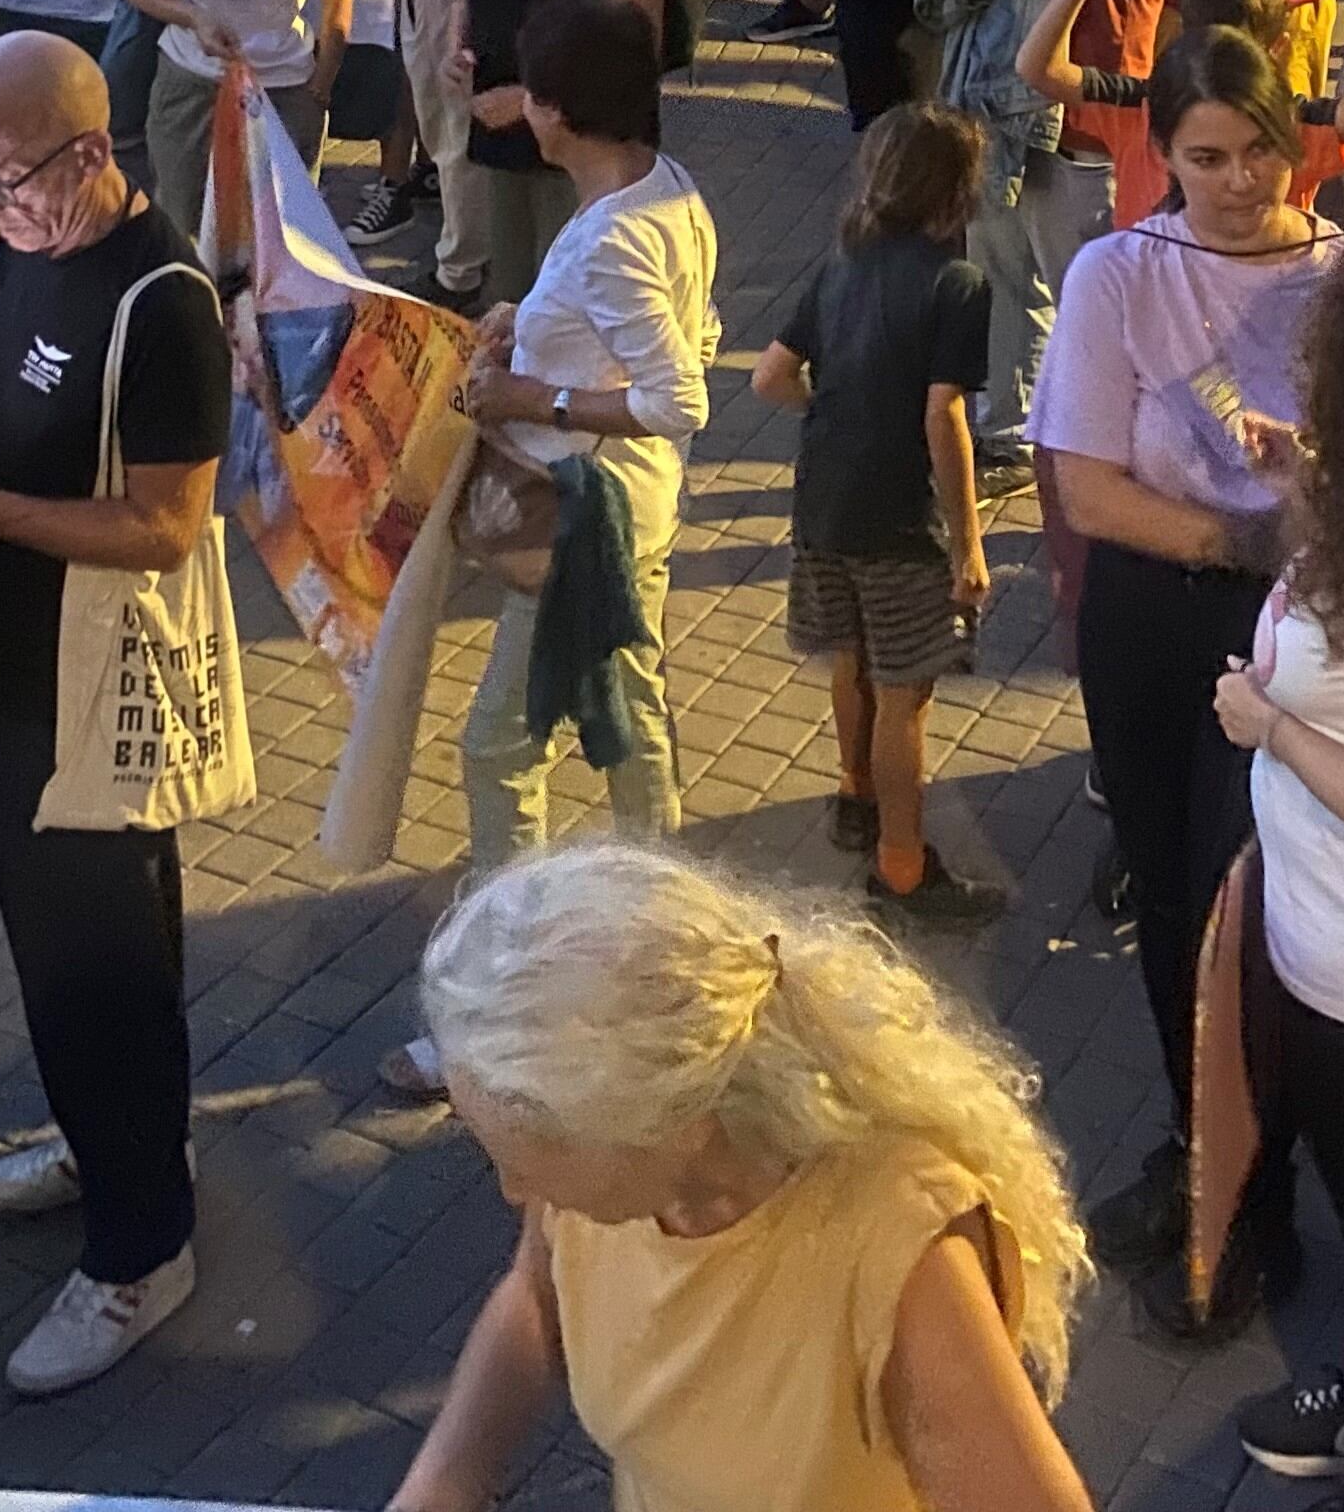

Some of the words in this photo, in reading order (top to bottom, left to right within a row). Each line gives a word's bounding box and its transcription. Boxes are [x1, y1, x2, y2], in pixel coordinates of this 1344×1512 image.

[119, 669, 159, 701] DE
[193, 664, 219, 699] LA
[113, 728, 224, 769] BALEAR
